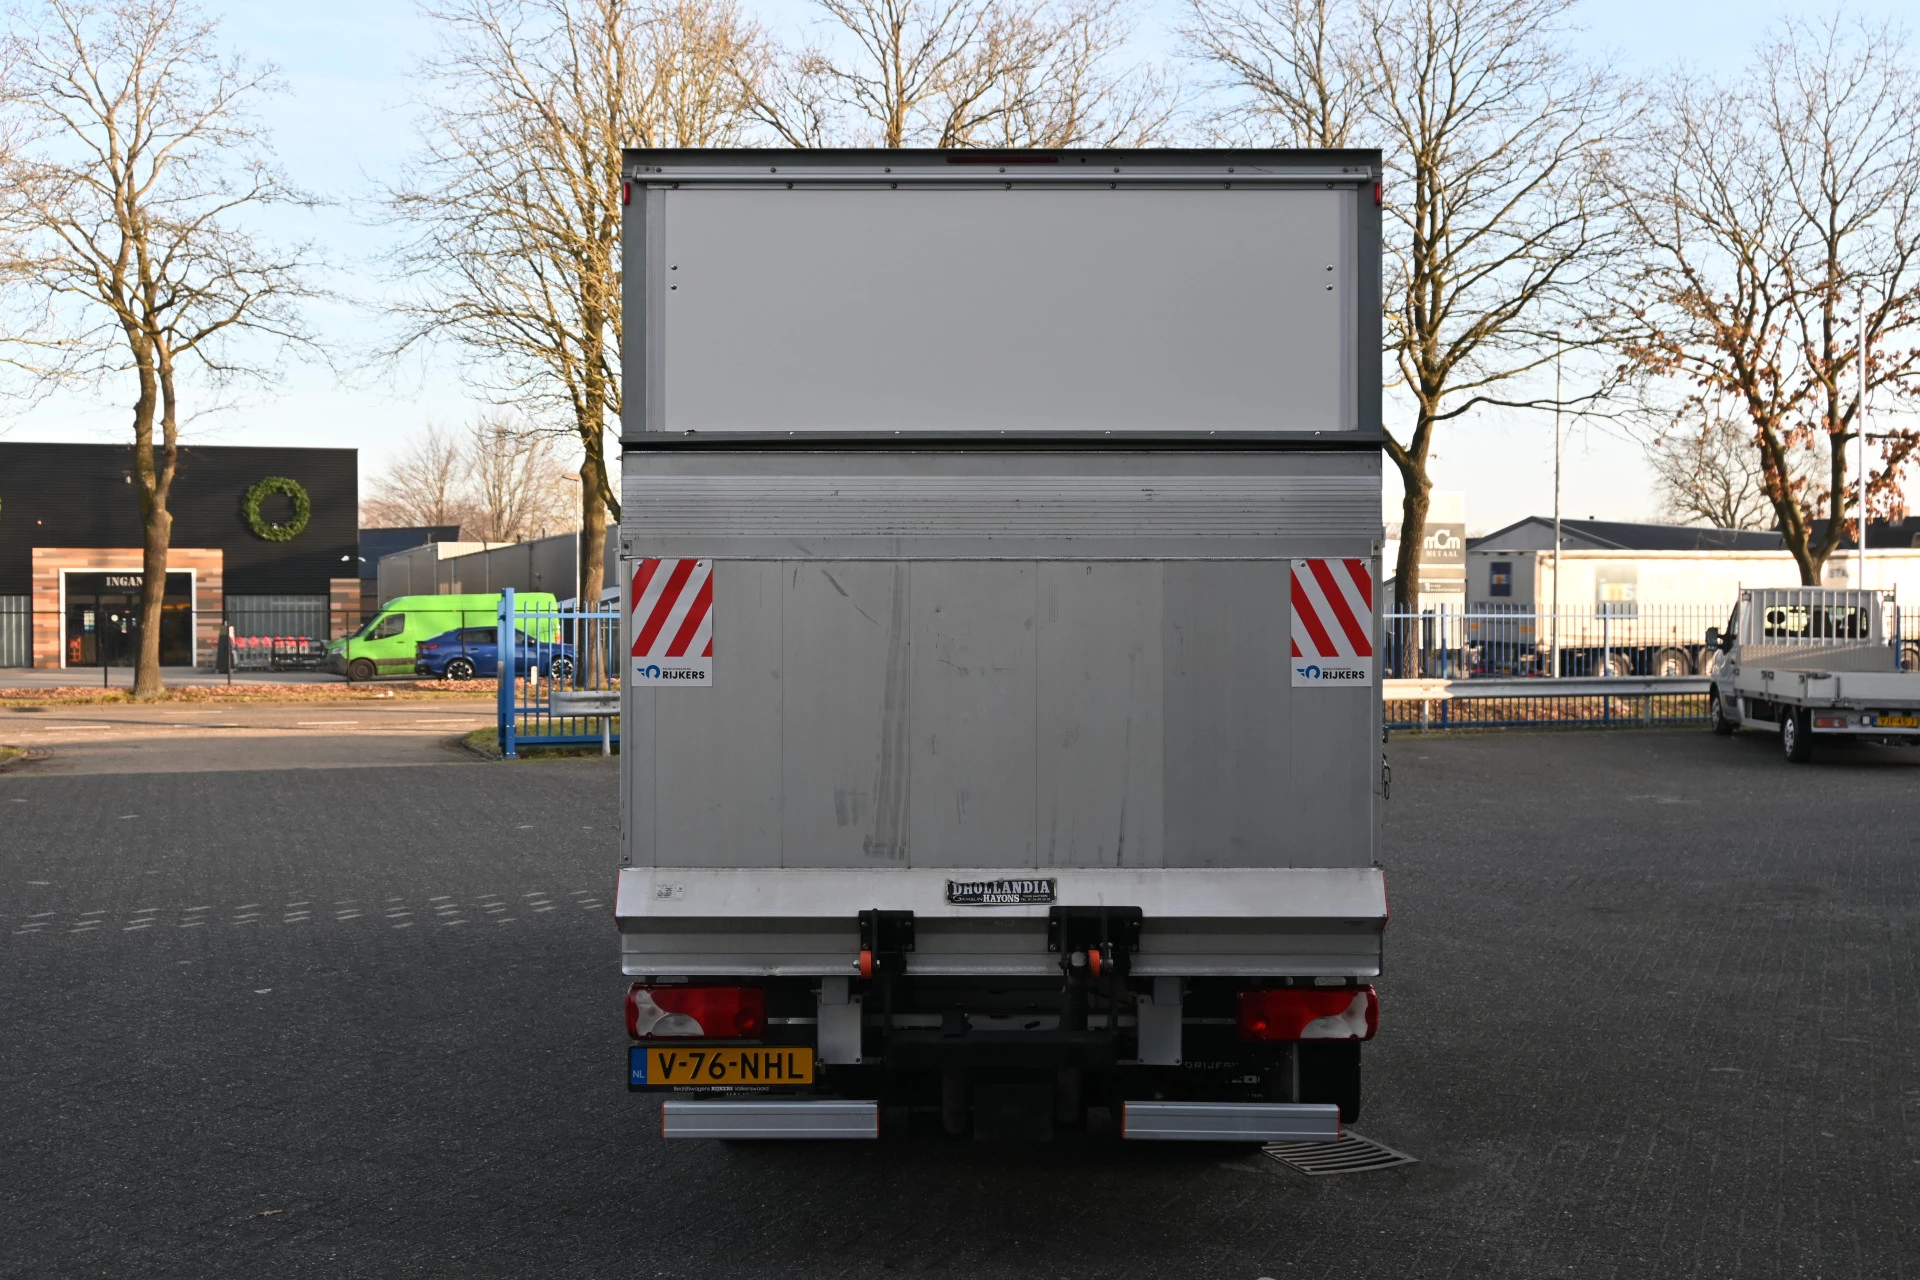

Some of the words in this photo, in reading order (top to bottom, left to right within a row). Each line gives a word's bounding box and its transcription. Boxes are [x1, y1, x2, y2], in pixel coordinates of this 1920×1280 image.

[106, 576, 143, 587] INGAN
[662, 670, 705, 680] RIJKERS
[1322, 670, 1365, 680] RIJKERS
[952, 880, 1050, 895] DHOLLANDIA
[982, 894, 1020, 903] HAYONS
[658, 1052, 804, 1080] V-76-NHL
[632, 1070, 645, 1079] NL
